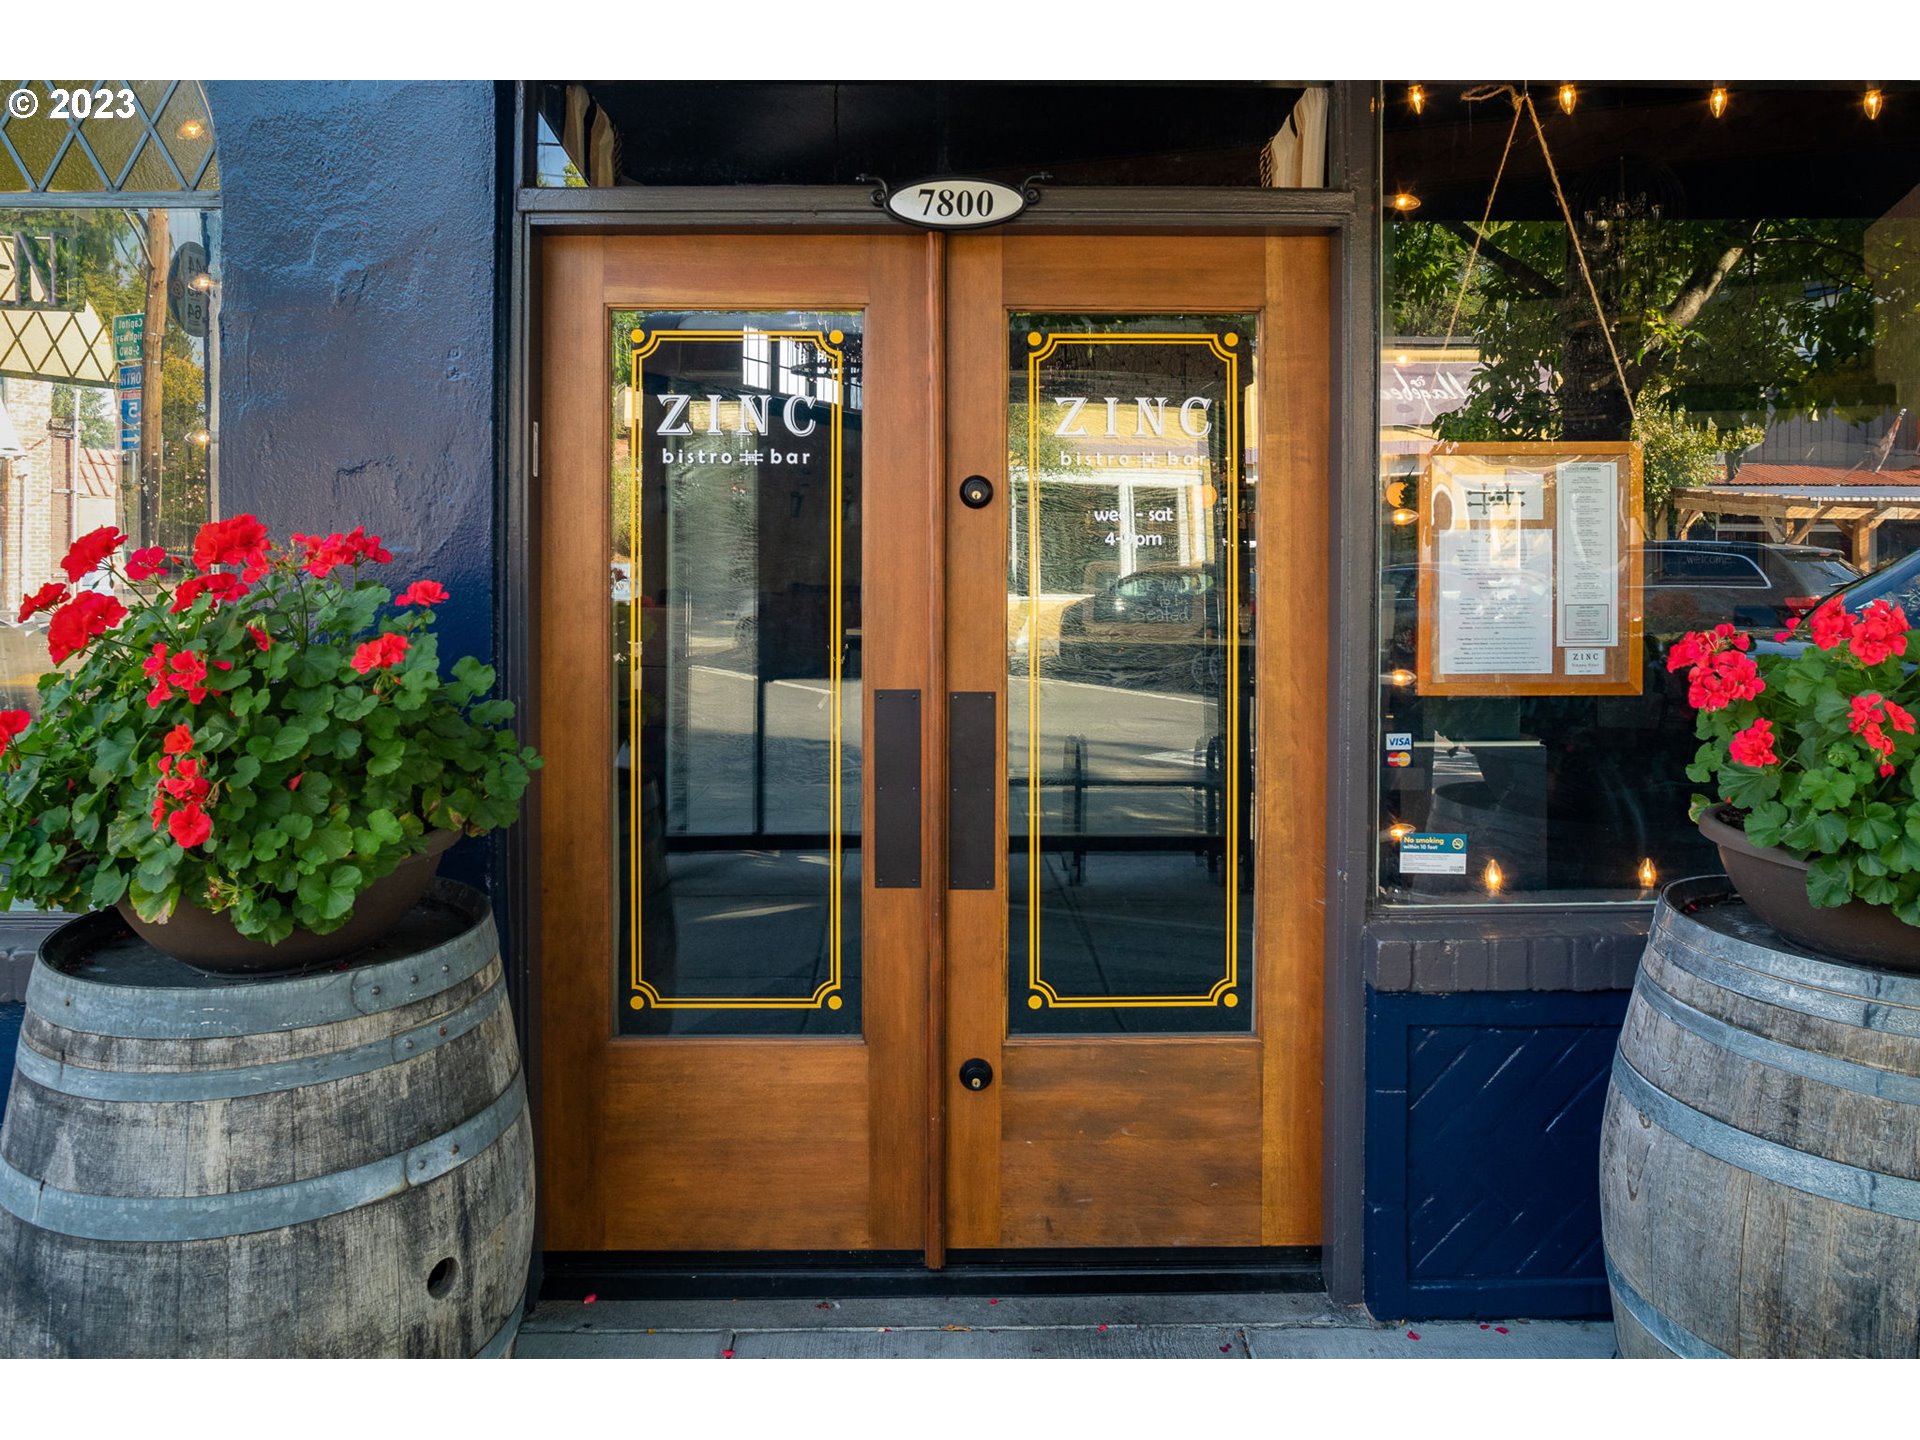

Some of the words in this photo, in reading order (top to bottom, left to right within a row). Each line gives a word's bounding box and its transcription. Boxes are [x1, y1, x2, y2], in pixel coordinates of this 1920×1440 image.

[918, 188, 994, 218] 7800
[656, 394, 818, 437] ZINC
[1054, 396, 1213, 438] ZINC
[662, 448, 733, 465] bistro
[770, 448, 811, 465] bar
[1060, 450, 1130, 466] bistro
[1167, 450, 1207, 466] bar
[1149, 507, 1174, 522] sat
[1388, 737, 1410, 746] VISA
[1403, 836, 1415, 844] No
[1415, 836, 1445, 846] smoking
